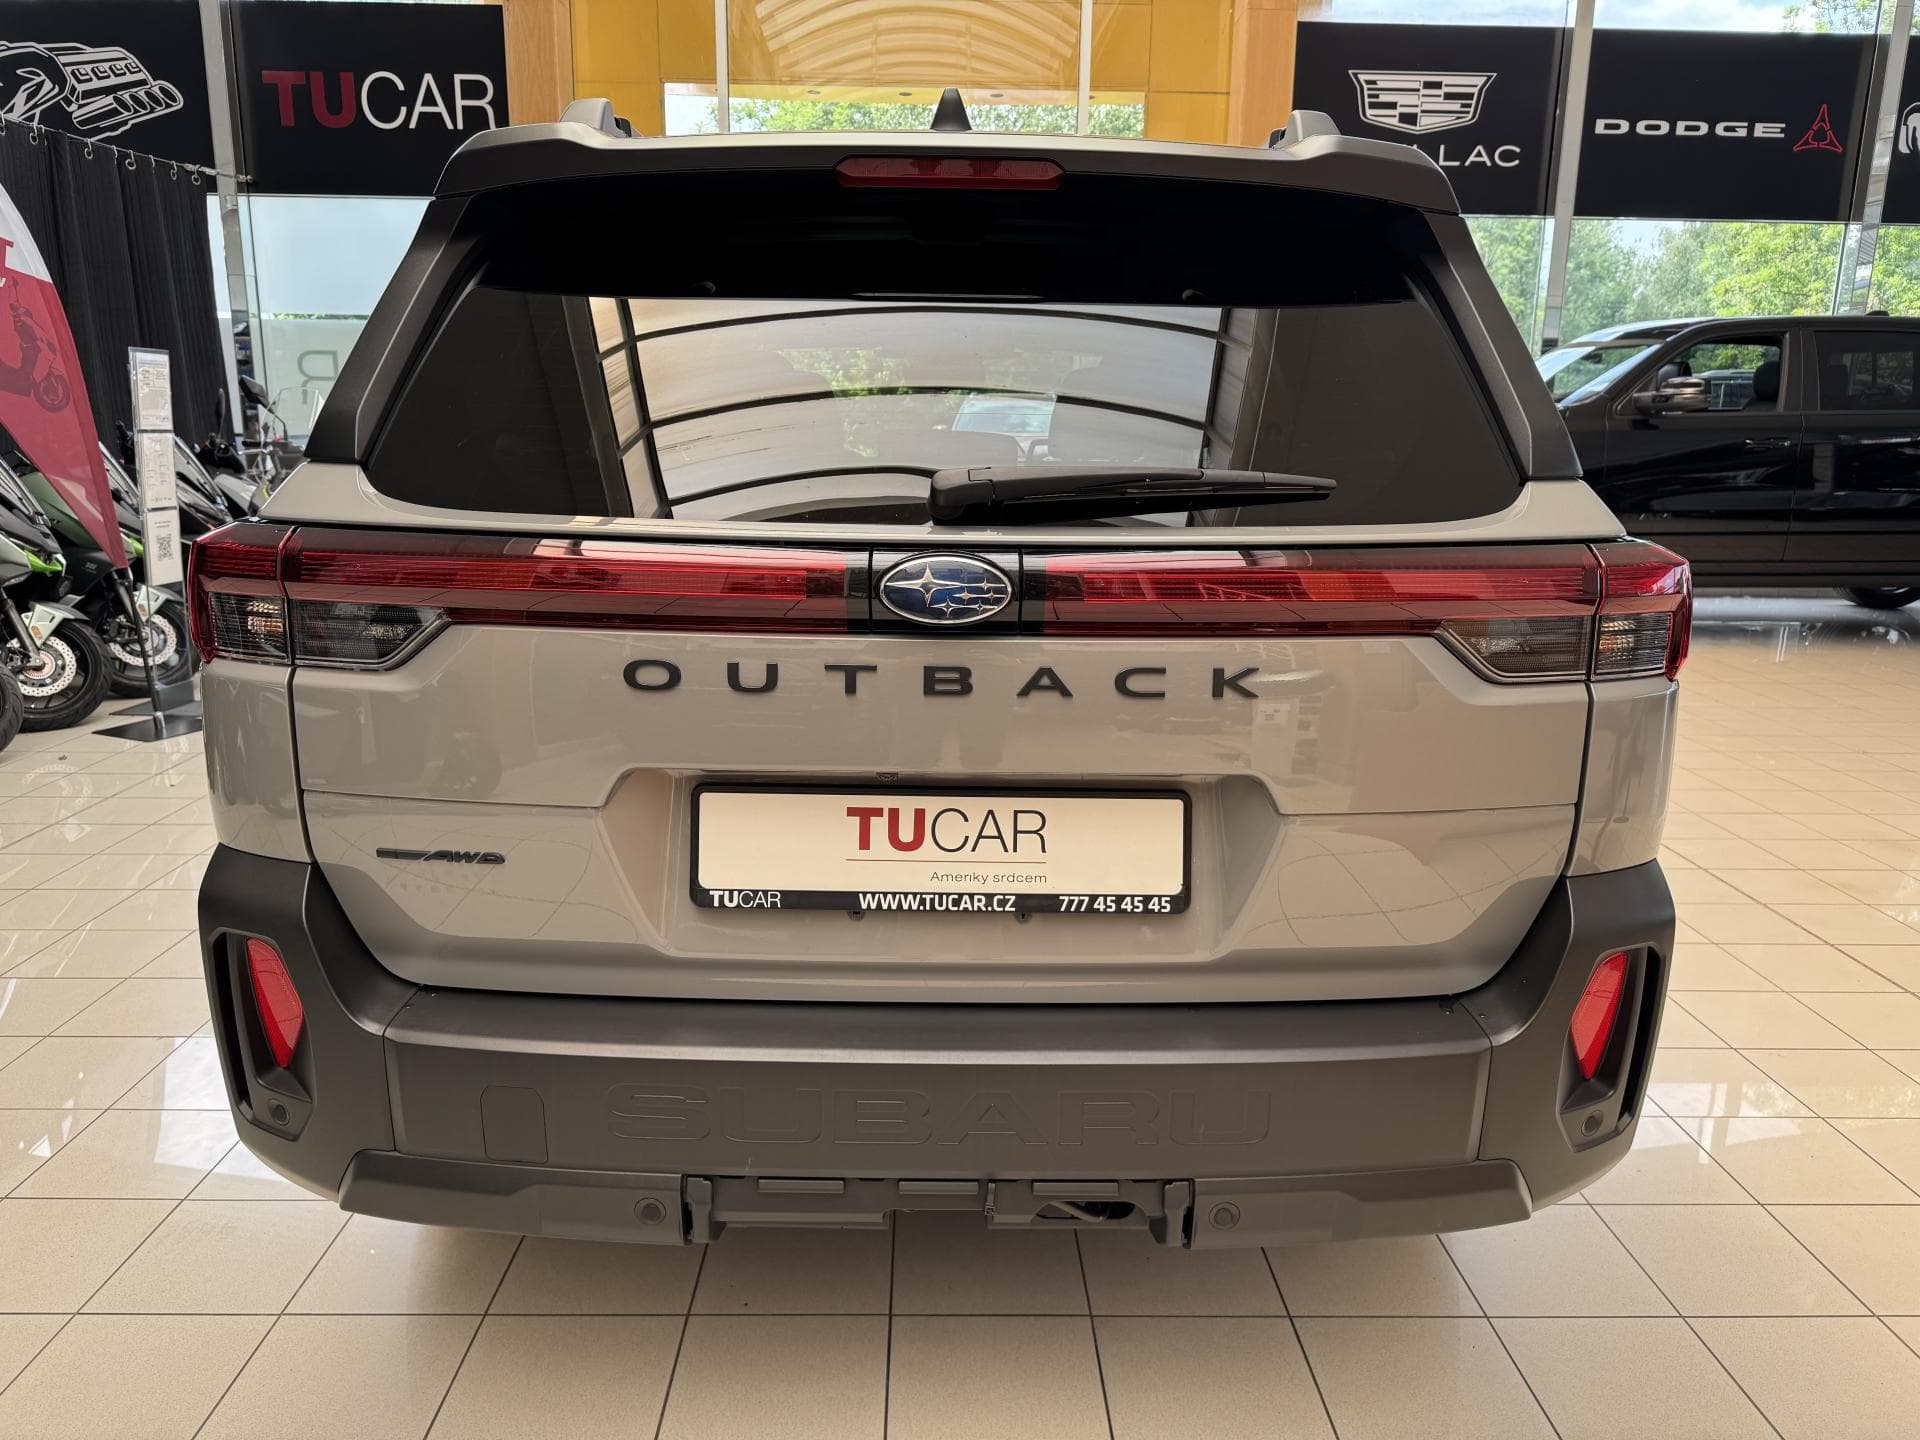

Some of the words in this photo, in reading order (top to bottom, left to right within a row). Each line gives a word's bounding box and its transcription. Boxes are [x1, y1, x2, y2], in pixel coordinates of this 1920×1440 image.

[261, 70, 496, 130] TUCAR
[1594, 118, 1786, 138] DODGE
[1412, 144, 1521, 167] LAC
[623, 659, 1260, 699] OUTBACK
[846, 806, 1047, 854] TUCAR
[422, 849, 506, 865] AWD
[992, 873, 1047, 884] srdcem
[709, 890, 781, 908] TUCAR
[858, 892, 1016, 912] WWW.TUCAR.CZ
[1058, 895, 1089, 911] 777
[1093, 896, 1116, 911] 45
[1120, 896, 1144, 912] 45
[1147, 896, 1171, 912] 45
[607, 1082, 1272, 1145] SUBARU
